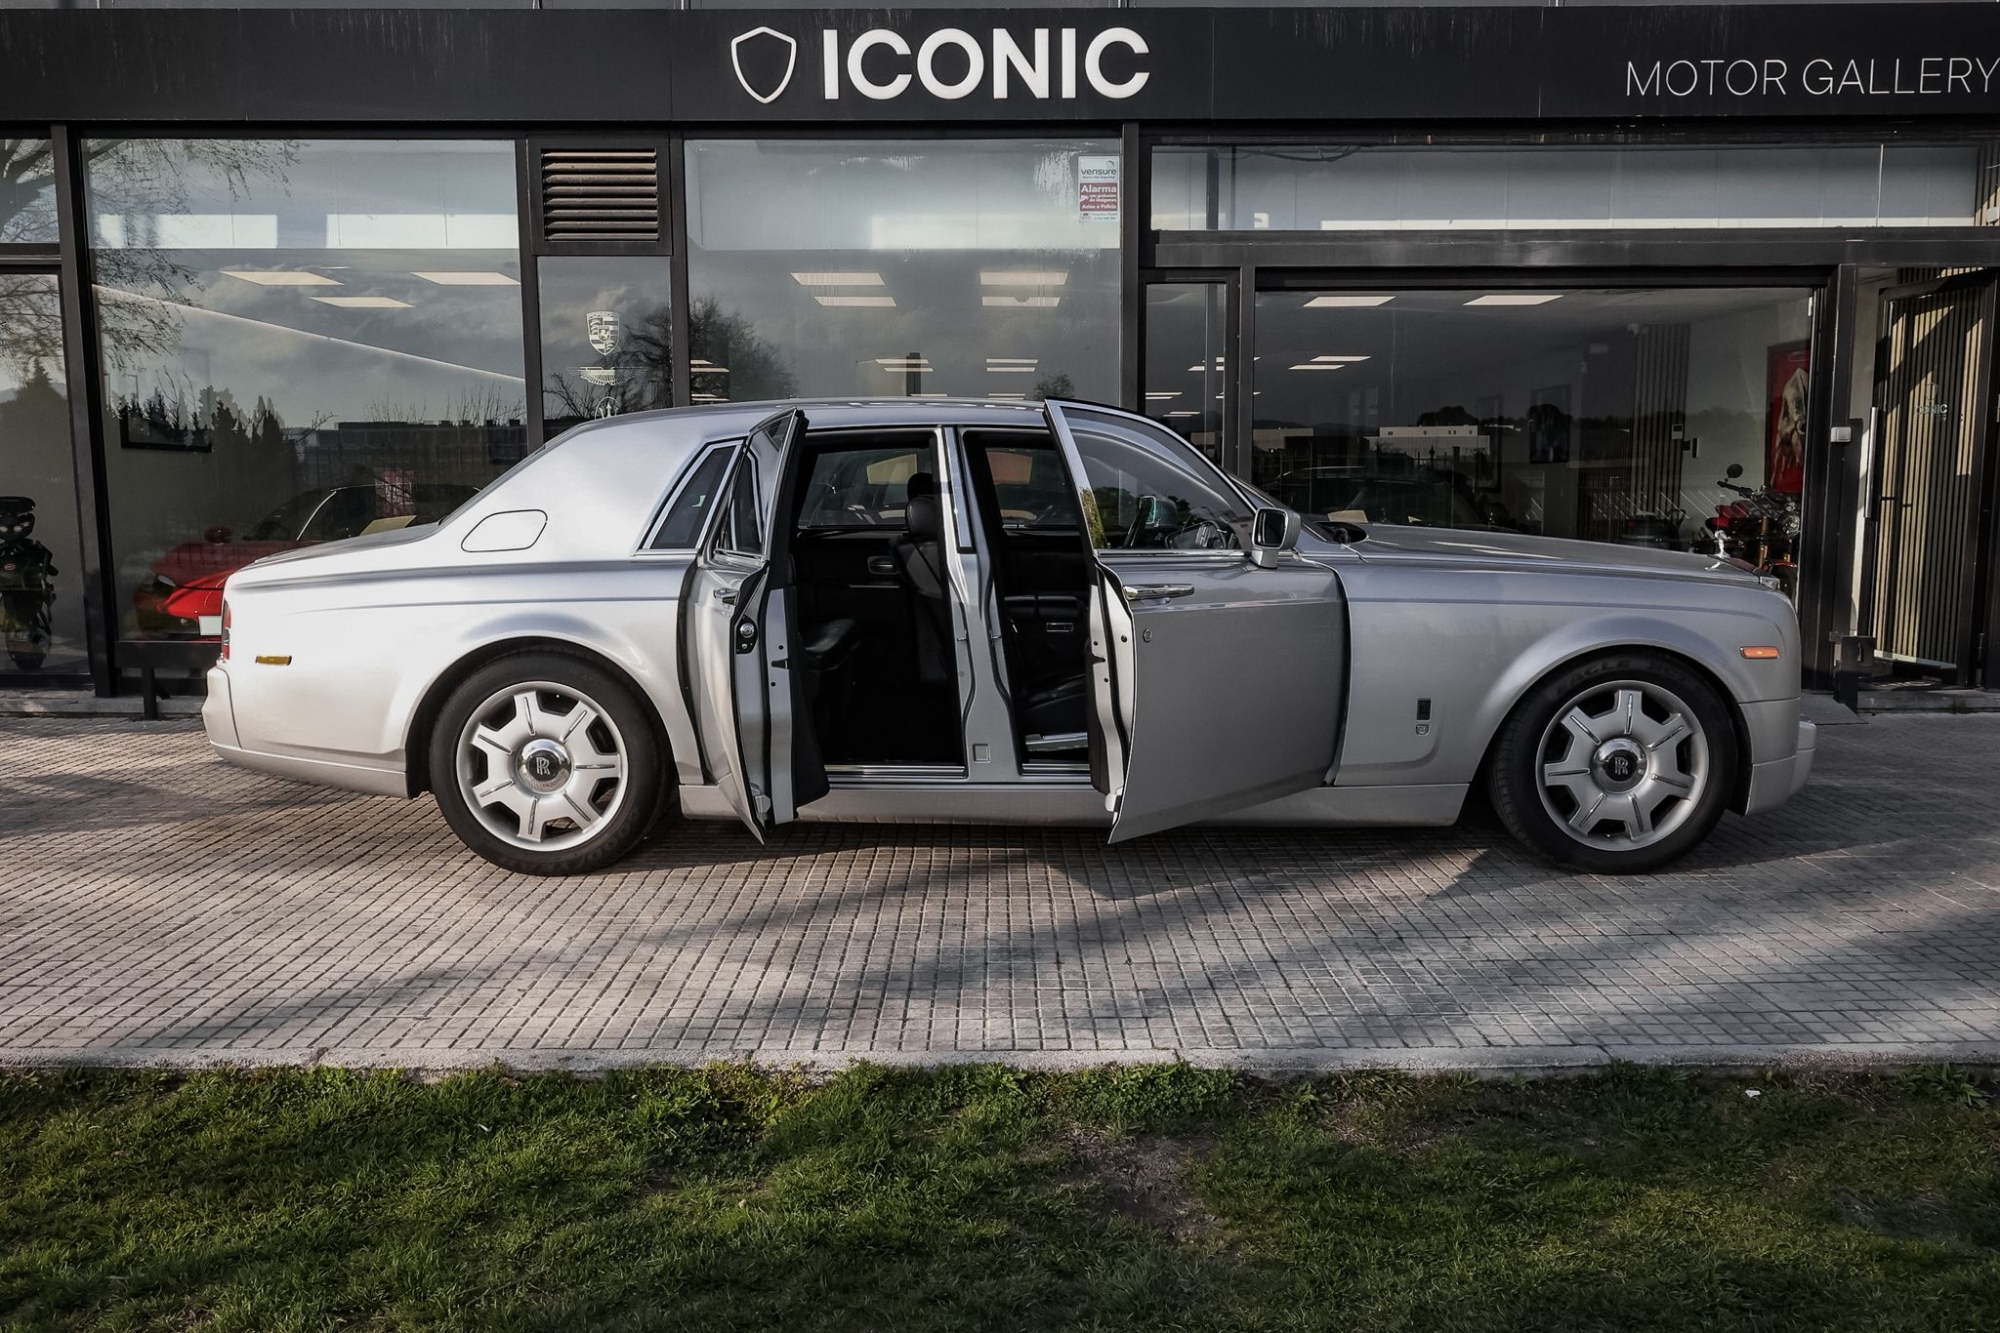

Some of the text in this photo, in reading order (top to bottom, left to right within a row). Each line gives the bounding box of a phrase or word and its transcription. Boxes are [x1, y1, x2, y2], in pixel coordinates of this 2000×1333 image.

[823, 26, 1150, 101] ICONIC
[1626, 57, 2000, 97] MOTOR GALLERY
[1081, 184, 1117, 193] Alarma
